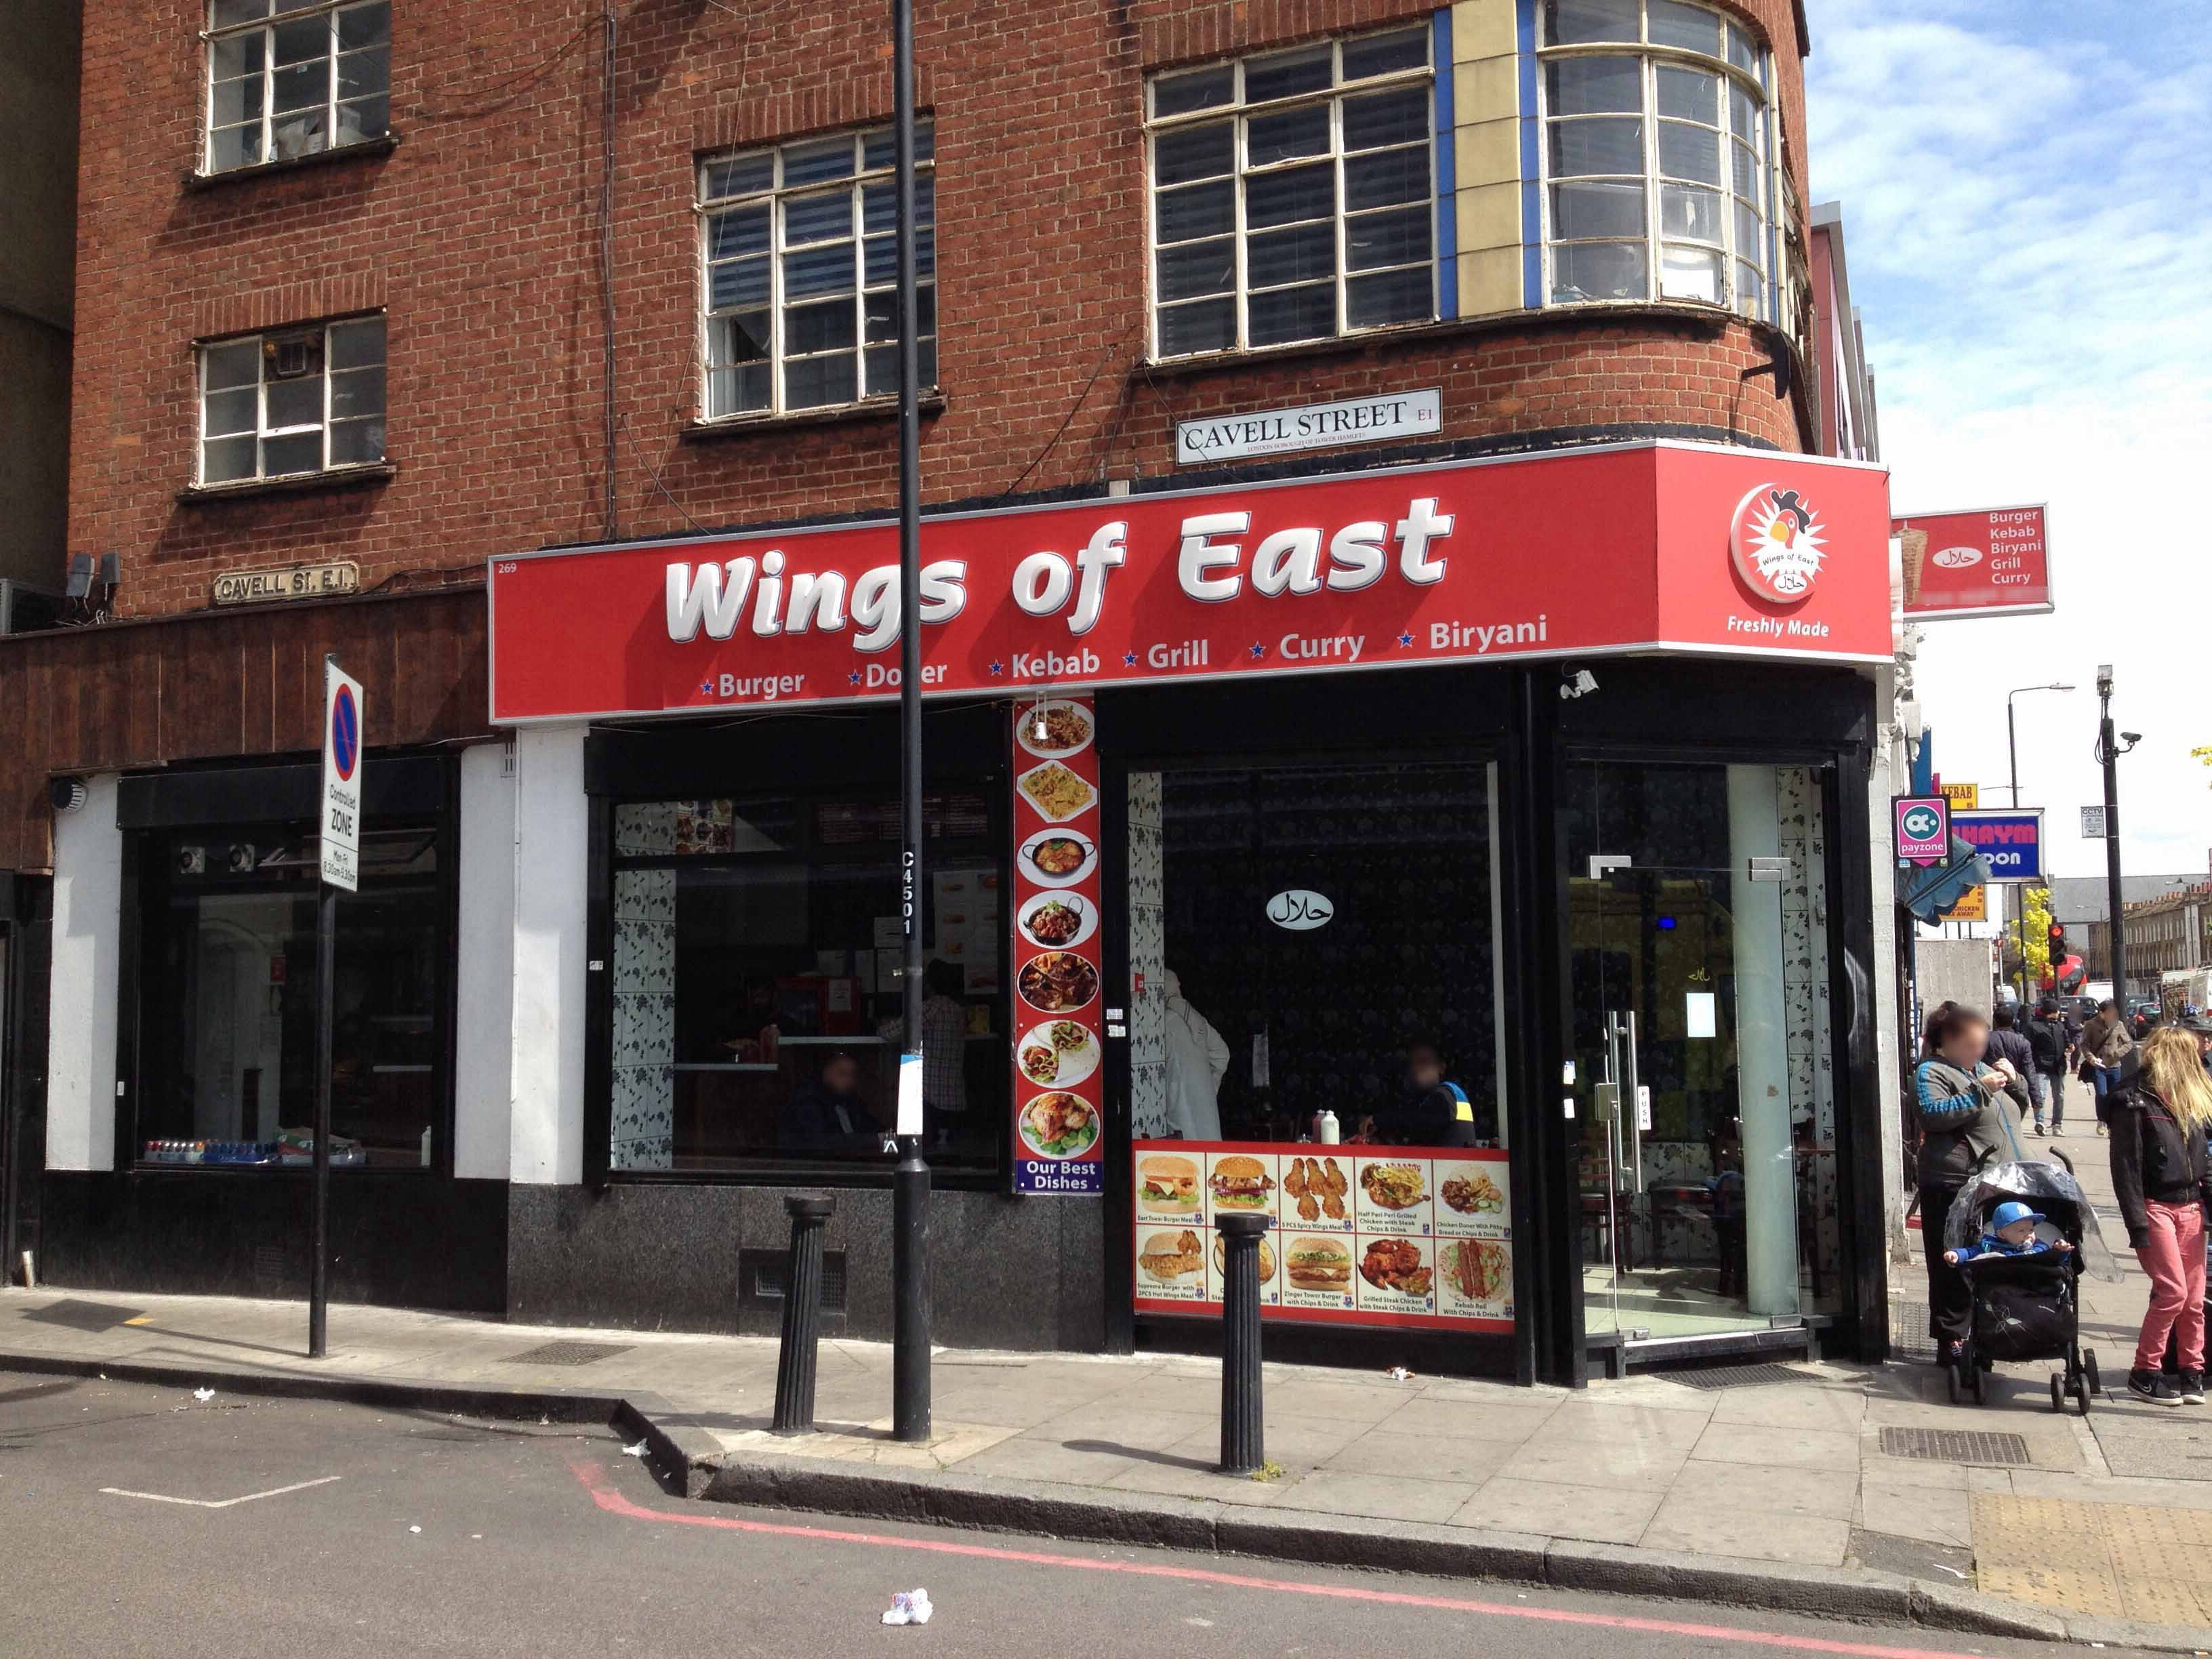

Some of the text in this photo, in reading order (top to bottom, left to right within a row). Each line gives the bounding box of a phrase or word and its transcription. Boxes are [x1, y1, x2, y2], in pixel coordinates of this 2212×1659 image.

[1185, 402, 1433, 450] CAVELL STREET E1
[1247, 444, 1274, 452] LONDON
[1274, 441, 1303, 449] BOROUGH
[1315, 436, 1337, 444] TOWER
[1337, 432, 1366, 441] HAMLETS
[1990, 510, 2039, 524] Burger
[1990, 526, 2035, 539] Kebab
[1991, 539, 2041, 555] Biryani
[1763, 554, 1784, 565] Wings
[1798, 554, 1814, 566] East
[1942, 550, 1973, 566] حلال
[1991, 558, 2021, 570] Grill
[499, 563, 516, 573] 269
[665, 497, 1455, 653] Wings of East
[1778, 576, 1804, 590] حلال
[1991, 573, 2030, 584] Curry
[222, 575, 285, 598] CAVELL
[1727, 615, 1830, 638] Freshly Made
[720, 614, 1548, 700] Burger Doer Kebab Grill Curry Biryani
[330, 783, 356, 810] Controlled
[1941, 786, 1972, 798] KEBAB
[331, 808, 352, 838] ZONE
[1902, 844, 1944, 854] payzone
[1273, 893, 1331, 922] حلال
[1027, 1161, 1095, 1174] Our Best
[1035, 1176, 1087, 1189] Dishes
